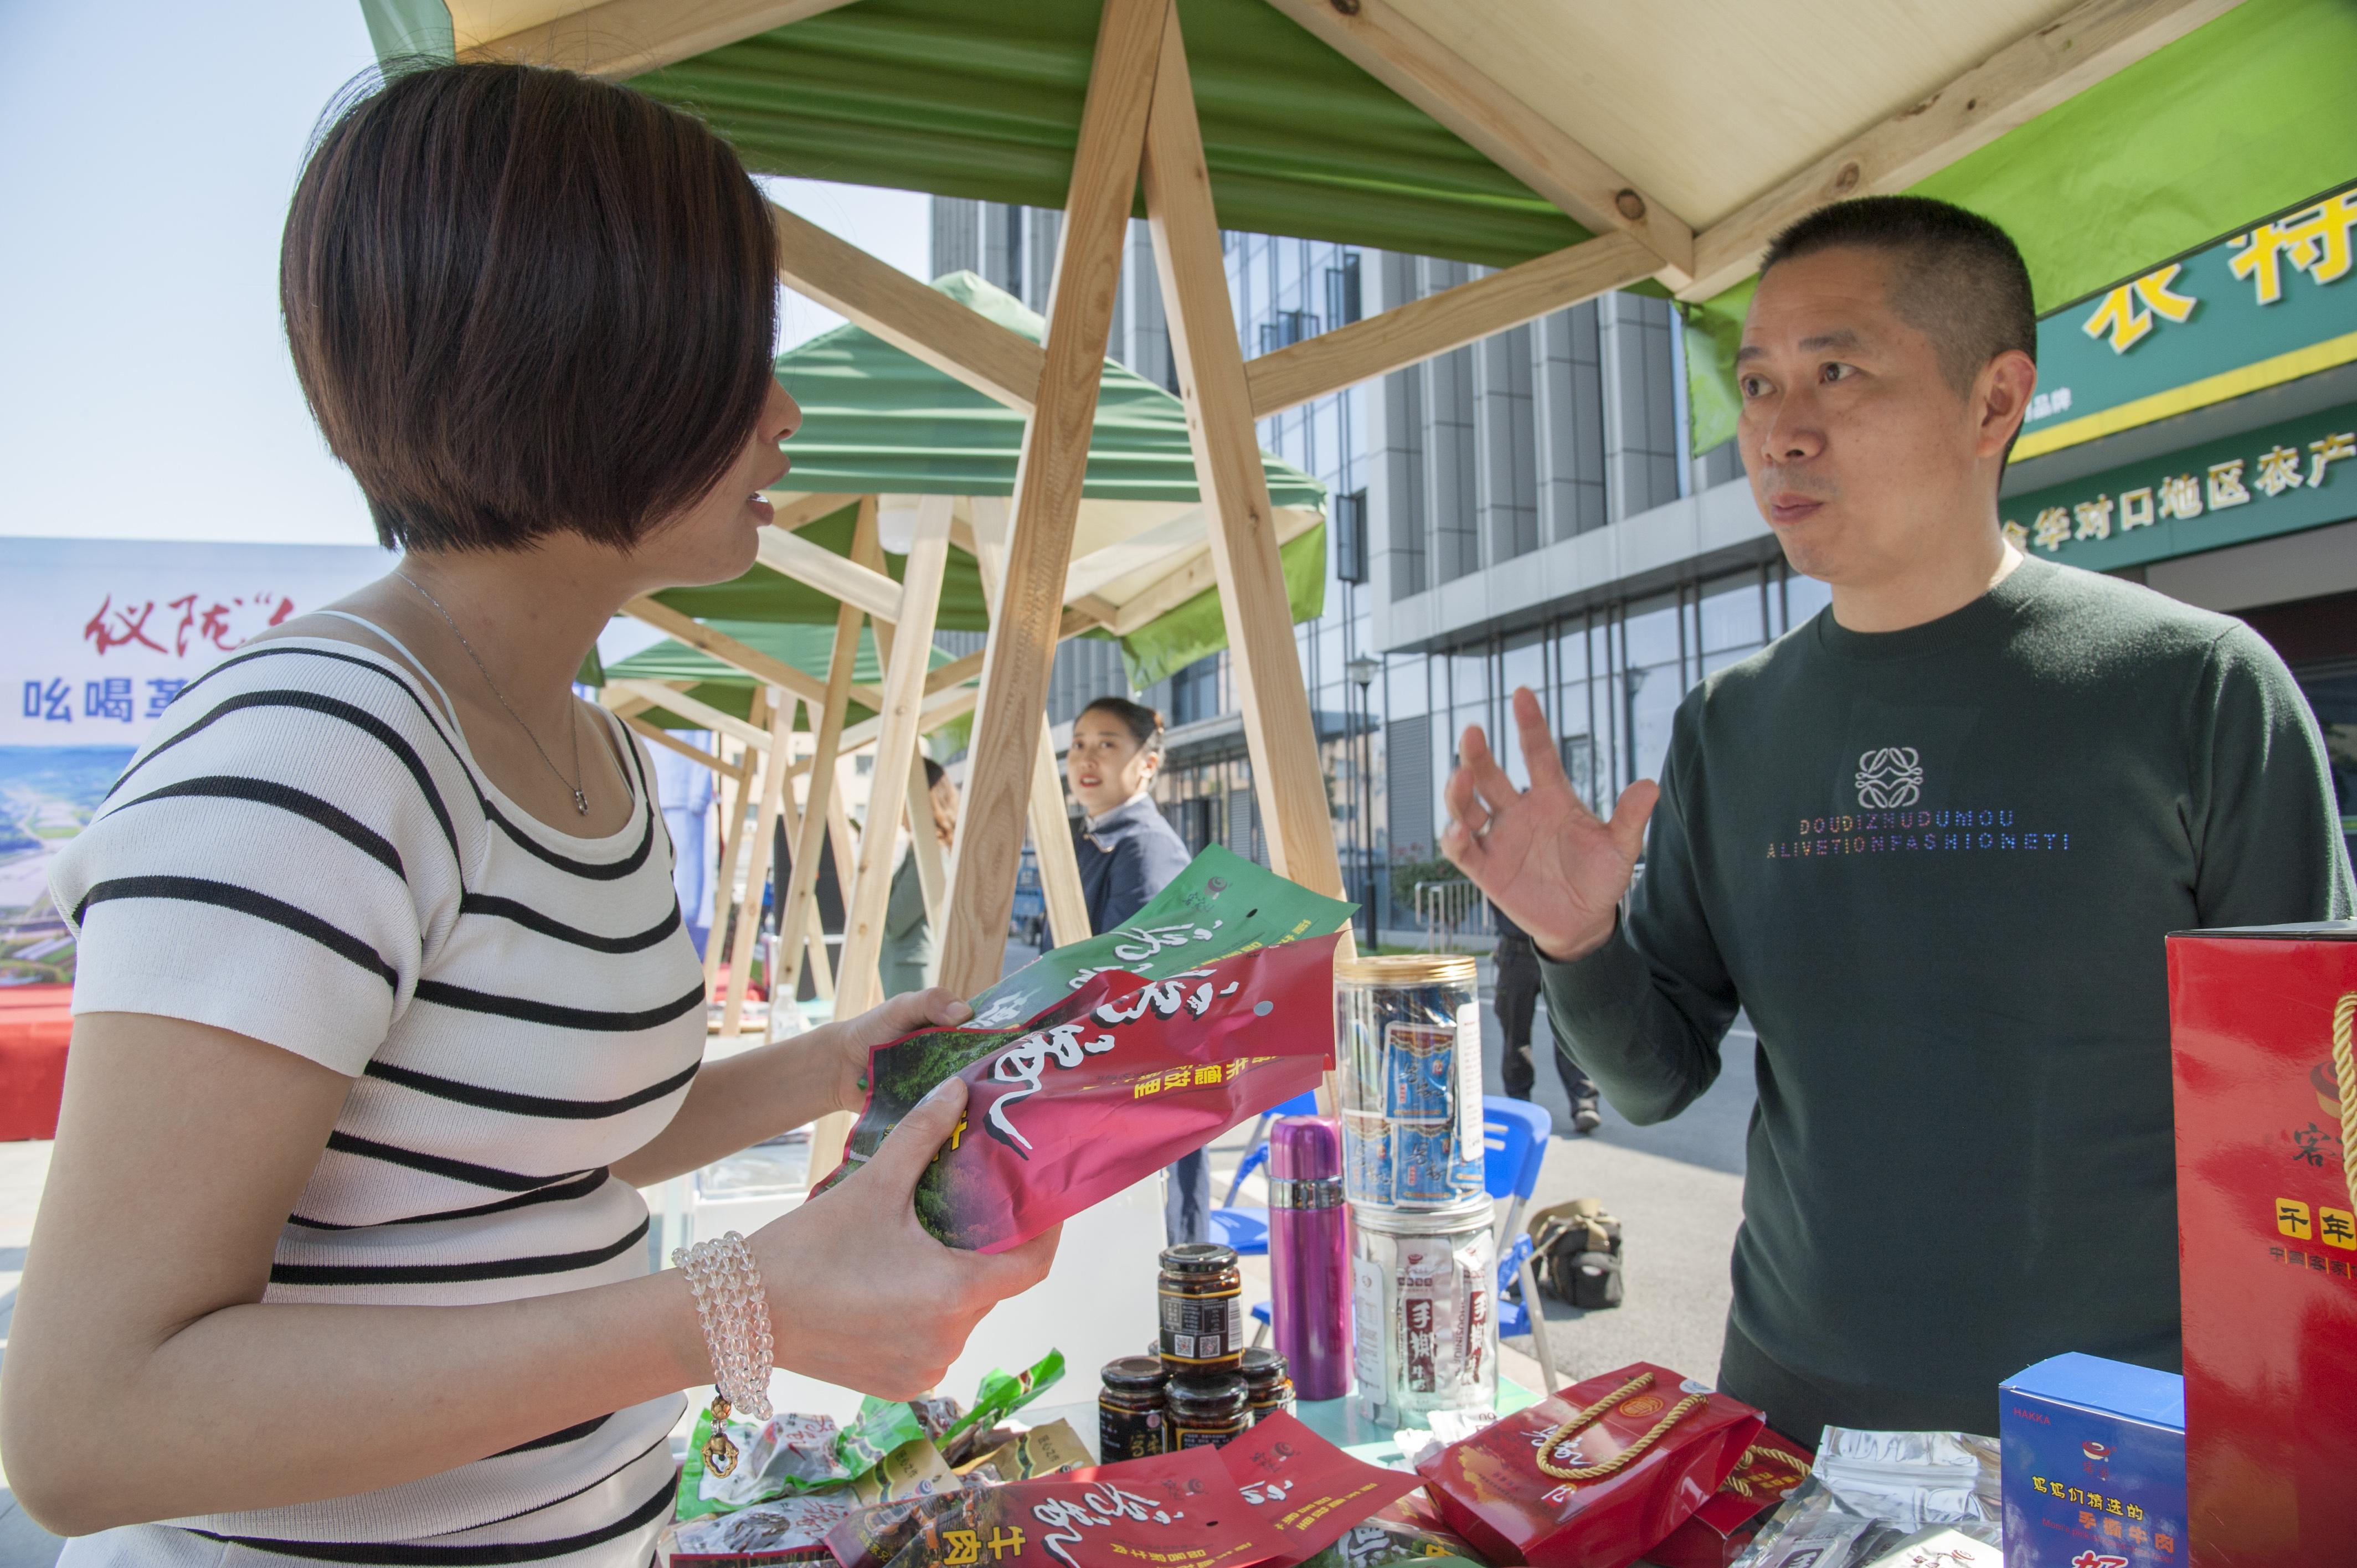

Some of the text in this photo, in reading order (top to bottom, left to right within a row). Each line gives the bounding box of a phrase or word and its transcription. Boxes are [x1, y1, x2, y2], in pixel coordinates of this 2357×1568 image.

[2024, 387, 2072, 424] 品牌
[2031, 1474, 2144, 1522] 妈妈们精选的
[943, 1525, 1026, 1566] 牛肉
